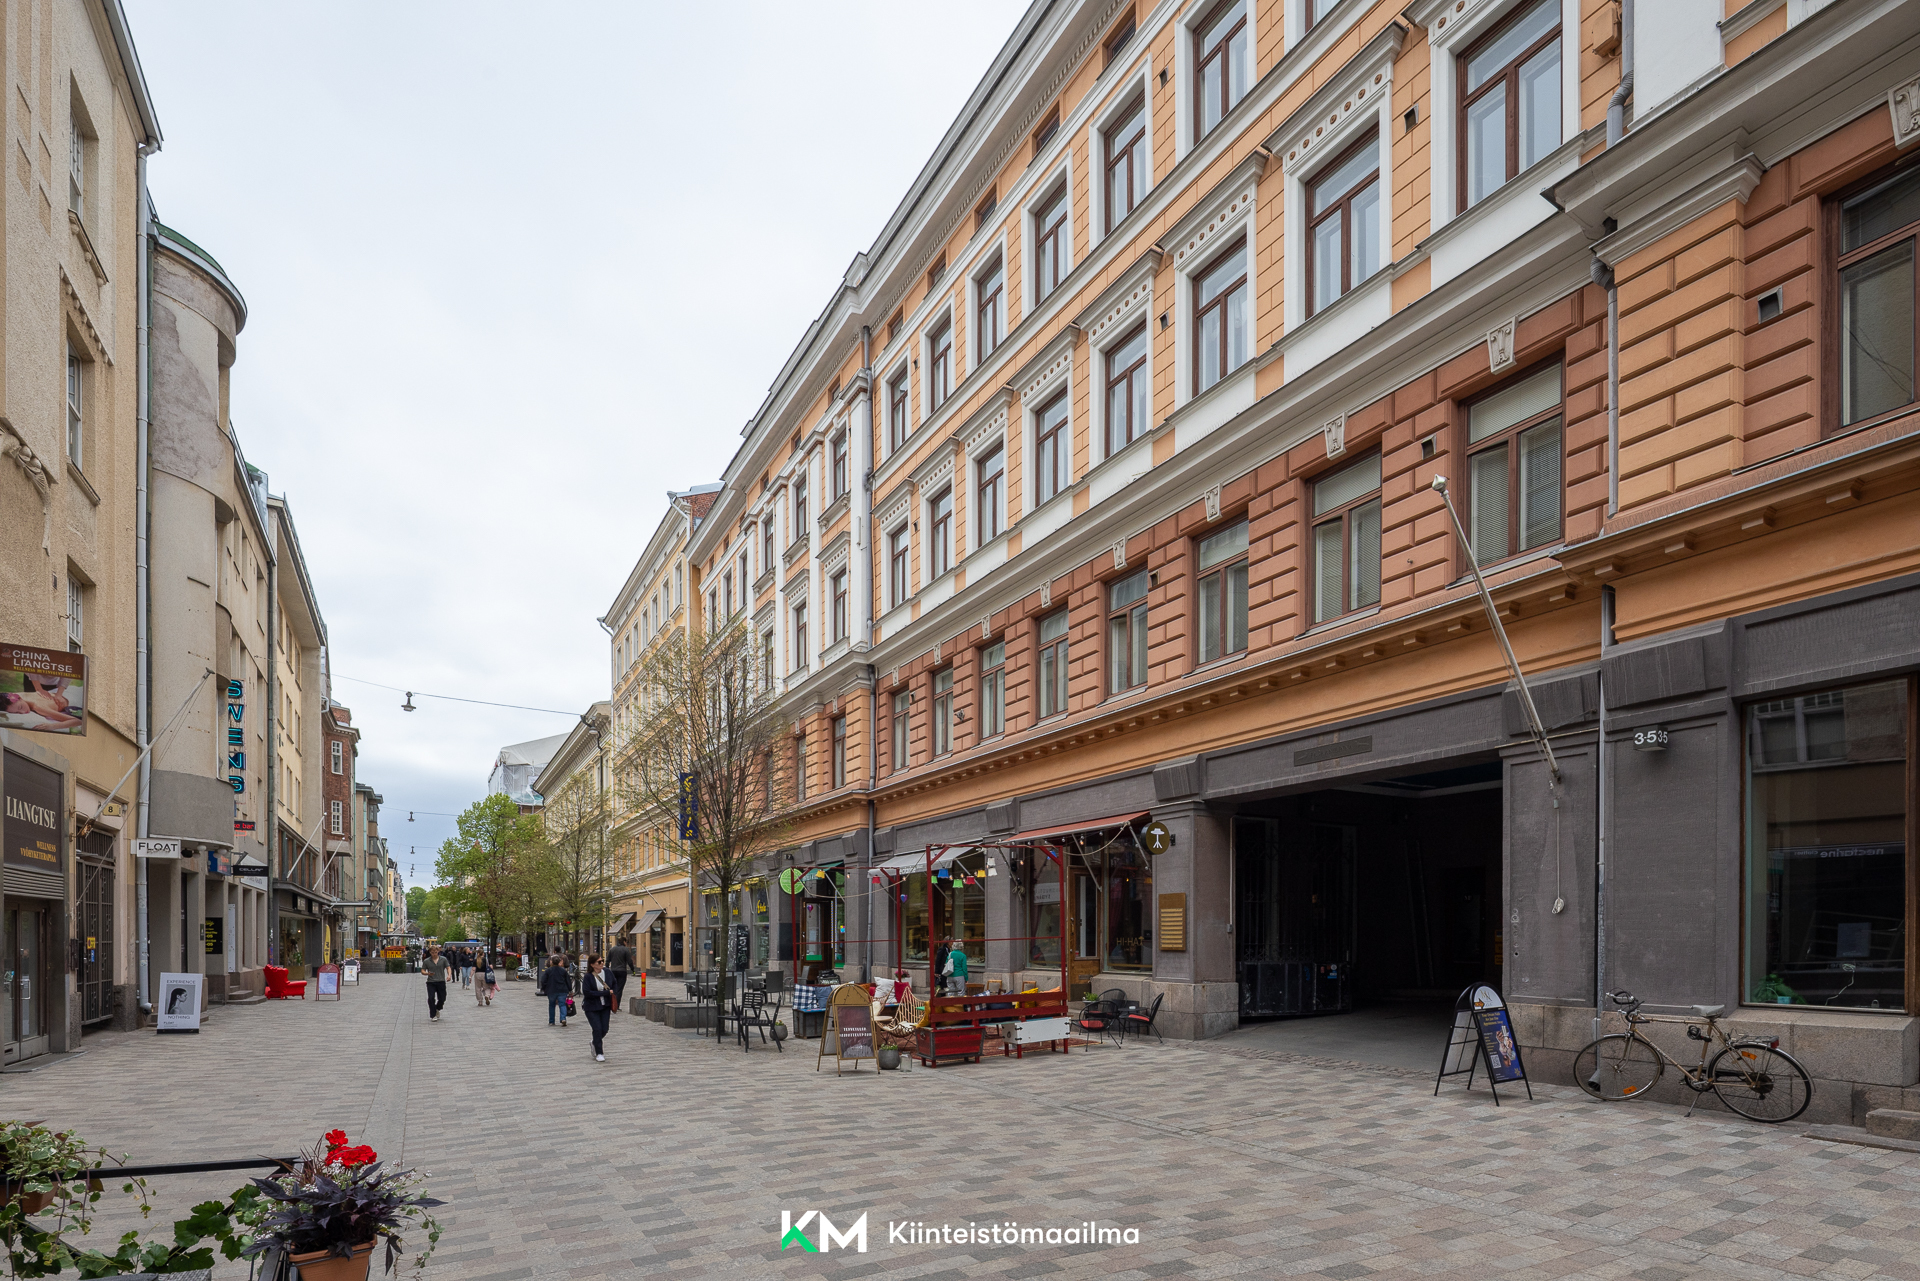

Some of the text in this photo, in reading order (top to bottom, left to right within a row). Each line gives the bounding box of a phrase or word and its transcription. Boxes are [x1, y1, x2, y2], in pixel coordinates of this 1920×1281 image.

[12, 649, 51, 662] CHINA
[13, 658, 73, 673] LIANGTSE
[1634, 730, 1657, 745] 3-5
[6, 795, 56, 830] LIANGTSE
[107, 805, 114, 813] 8
[138, 842, 178, 852] FLOAT
